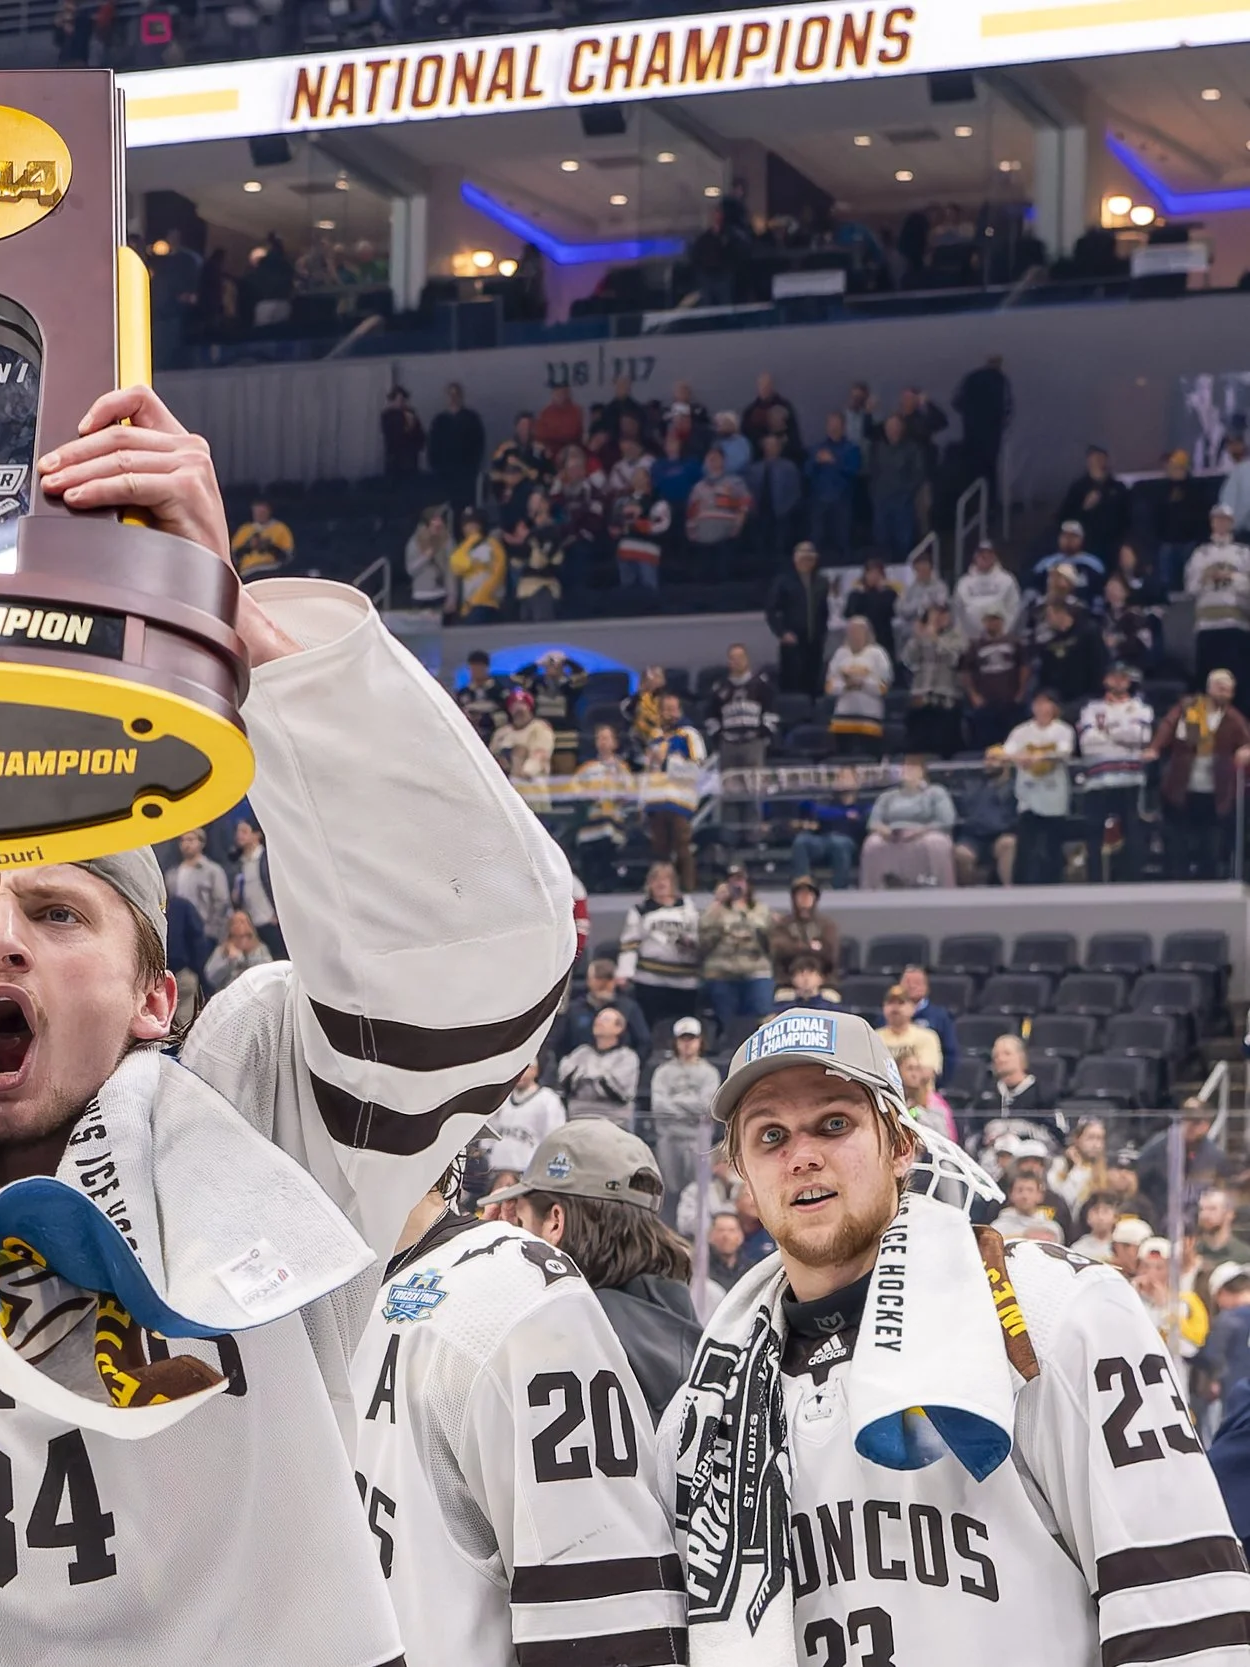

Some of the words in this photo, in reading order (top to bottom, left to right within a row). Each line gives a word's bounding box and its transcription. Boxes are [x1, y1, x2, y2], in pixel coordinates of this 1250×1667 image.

[290, 44, 543, 121] NATIONAL
[567, 7, 916, 94] CHAMPIONS
[16, 363, 28, 383] I
[761, 1033, 828, 1058] CHAMPIONS
[763, 1018, 829, 1043] NATIONAL
[75, 1151, 120, 1202] ICE
[881, 1225, 908, 1256] ICE
[874, 1264, 906, 1353] HOCKEY
[365, 1333, 401, 1425] A
[808, 1347, 848, 1366] adidas
[527, 1369, 638, 1483] 20
[1093, 1353, 1203, 1469] 23
[745, 1413, 759, 1474] LOUIS
[687, 1438, 733, 1601] FROZEN
[743, 1478, 756, 1509] ST.
